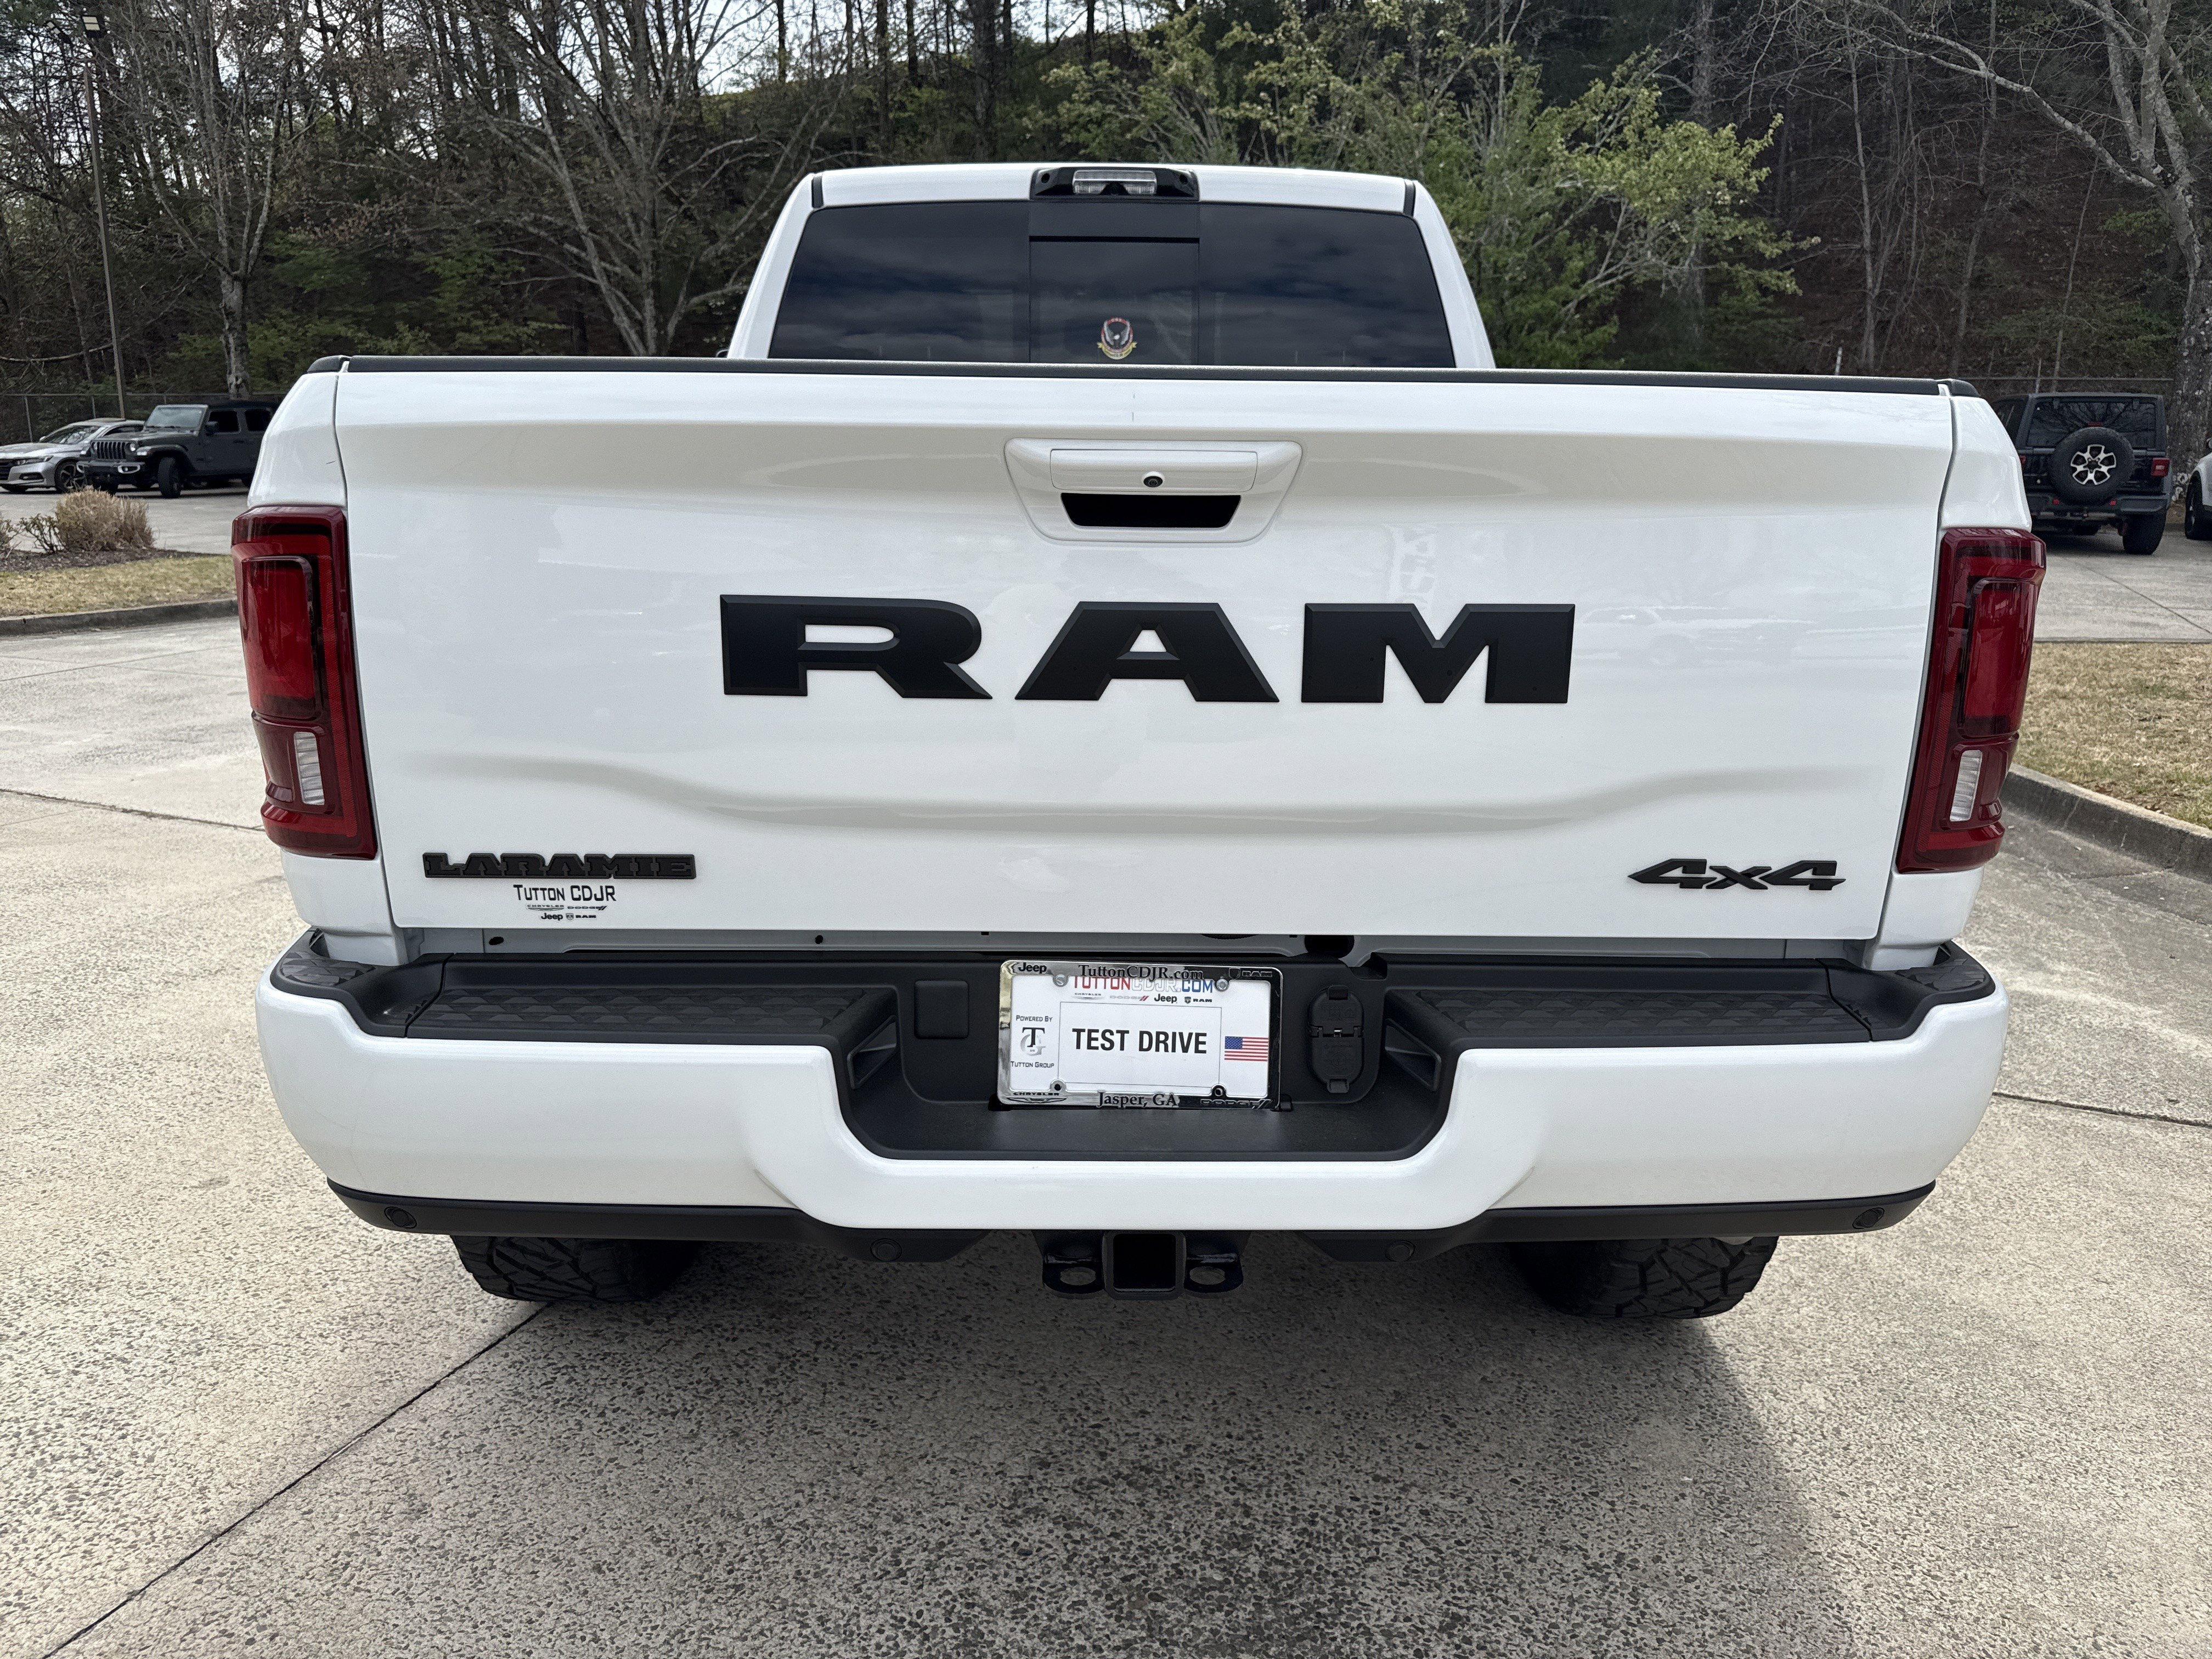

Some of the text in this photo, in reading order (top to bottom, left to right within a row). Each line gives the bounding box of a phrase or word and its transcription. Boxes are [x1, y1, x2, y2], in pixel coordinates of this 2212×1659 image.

[720, 594, 1575, 704] RAM
[422, 852, 696, 879] LARAMIE
[1628, 858, 1846, 890] 4x4
[513, 884, 617, 901] TUTTON CDJR
[541, 913, 563, 921] Jeep
[1018, 962, 1047, 974] Jeep
[1078, 964, 1204, 982] TuttonCDJR.com
[1154, 994, 1177, 1003] Jeep
[1072, 1028, 1207, 1054] TEST DRIVE
[1098, 1091, 1178, 1108] Jasper, GA
